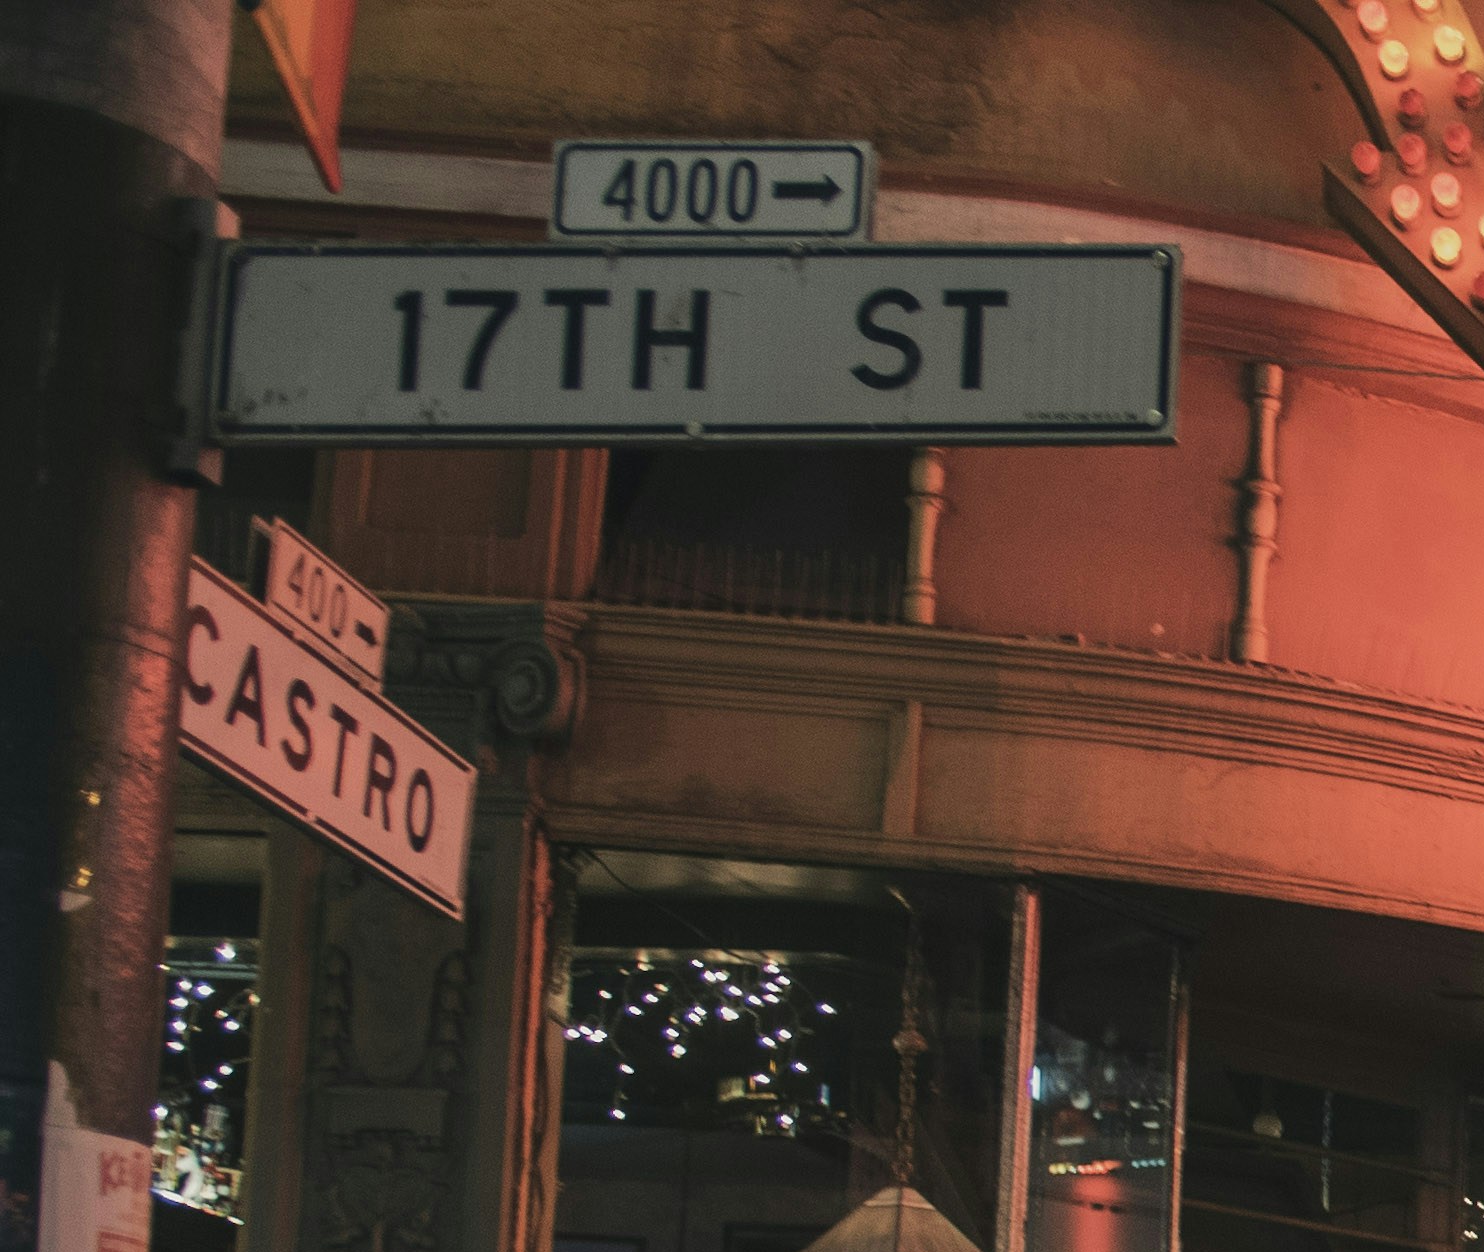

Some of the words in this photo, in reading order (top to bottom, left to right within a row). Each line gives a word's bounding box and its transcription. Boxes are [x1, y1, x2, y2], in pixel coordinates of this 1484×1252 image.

[602, 157, 760, 225] 4000
[393, 288, 710, 392] 17TH
[849, 287, 1010, 392] ST
[287, 553, 349, 638] 400
[181, 603, 435, 854] CASTRO
